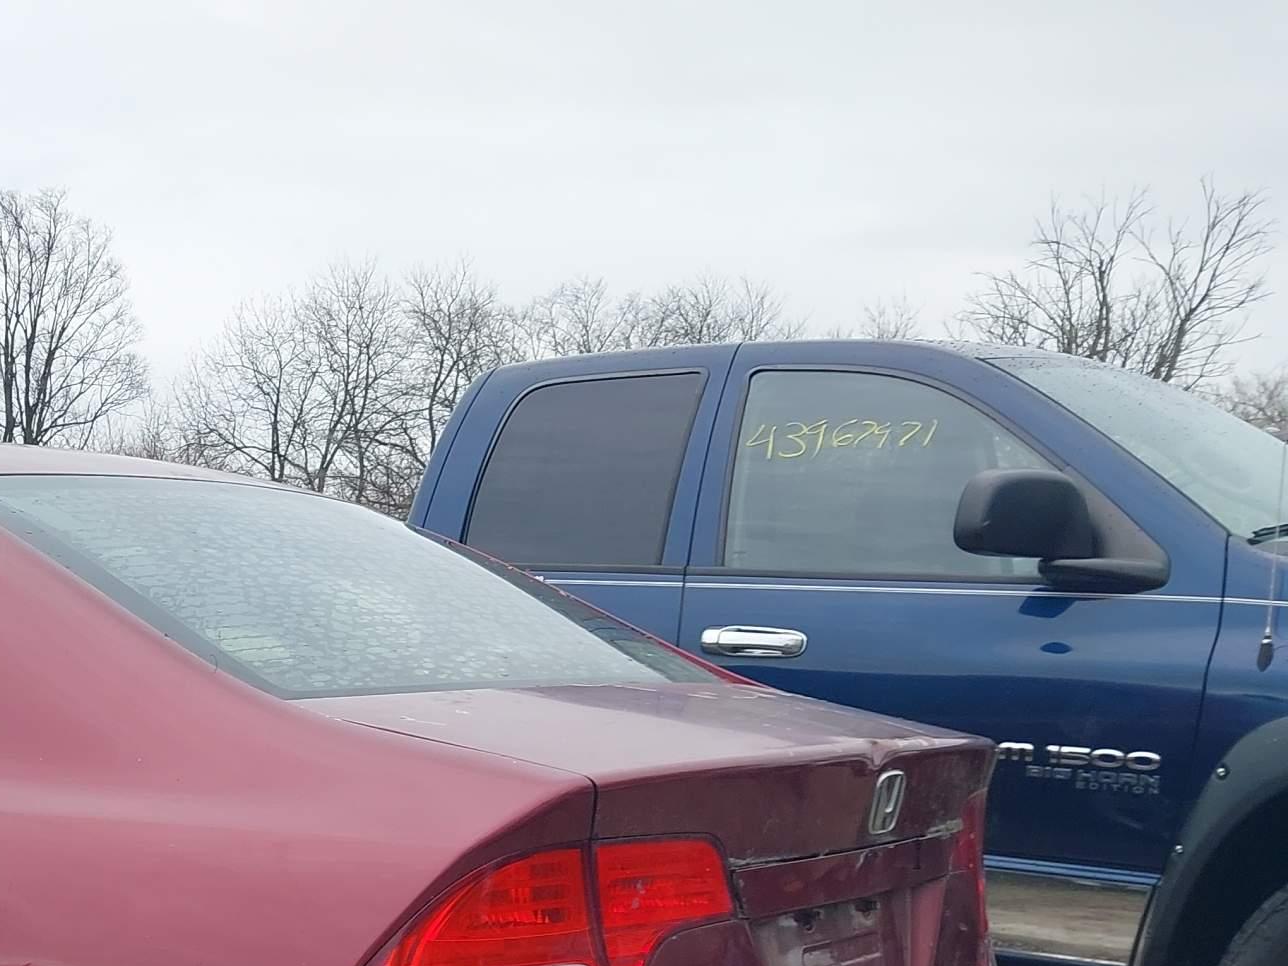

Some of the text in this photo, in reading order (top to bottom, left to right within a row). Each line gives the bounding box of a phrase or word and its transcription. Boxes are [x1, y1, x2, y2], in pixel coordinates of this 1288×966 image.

[1046, 744, 1161, 771] 1500
[1026, 765, 1160, 787] BIG HORN
[1075, 780, 1160, 794] EDITION
